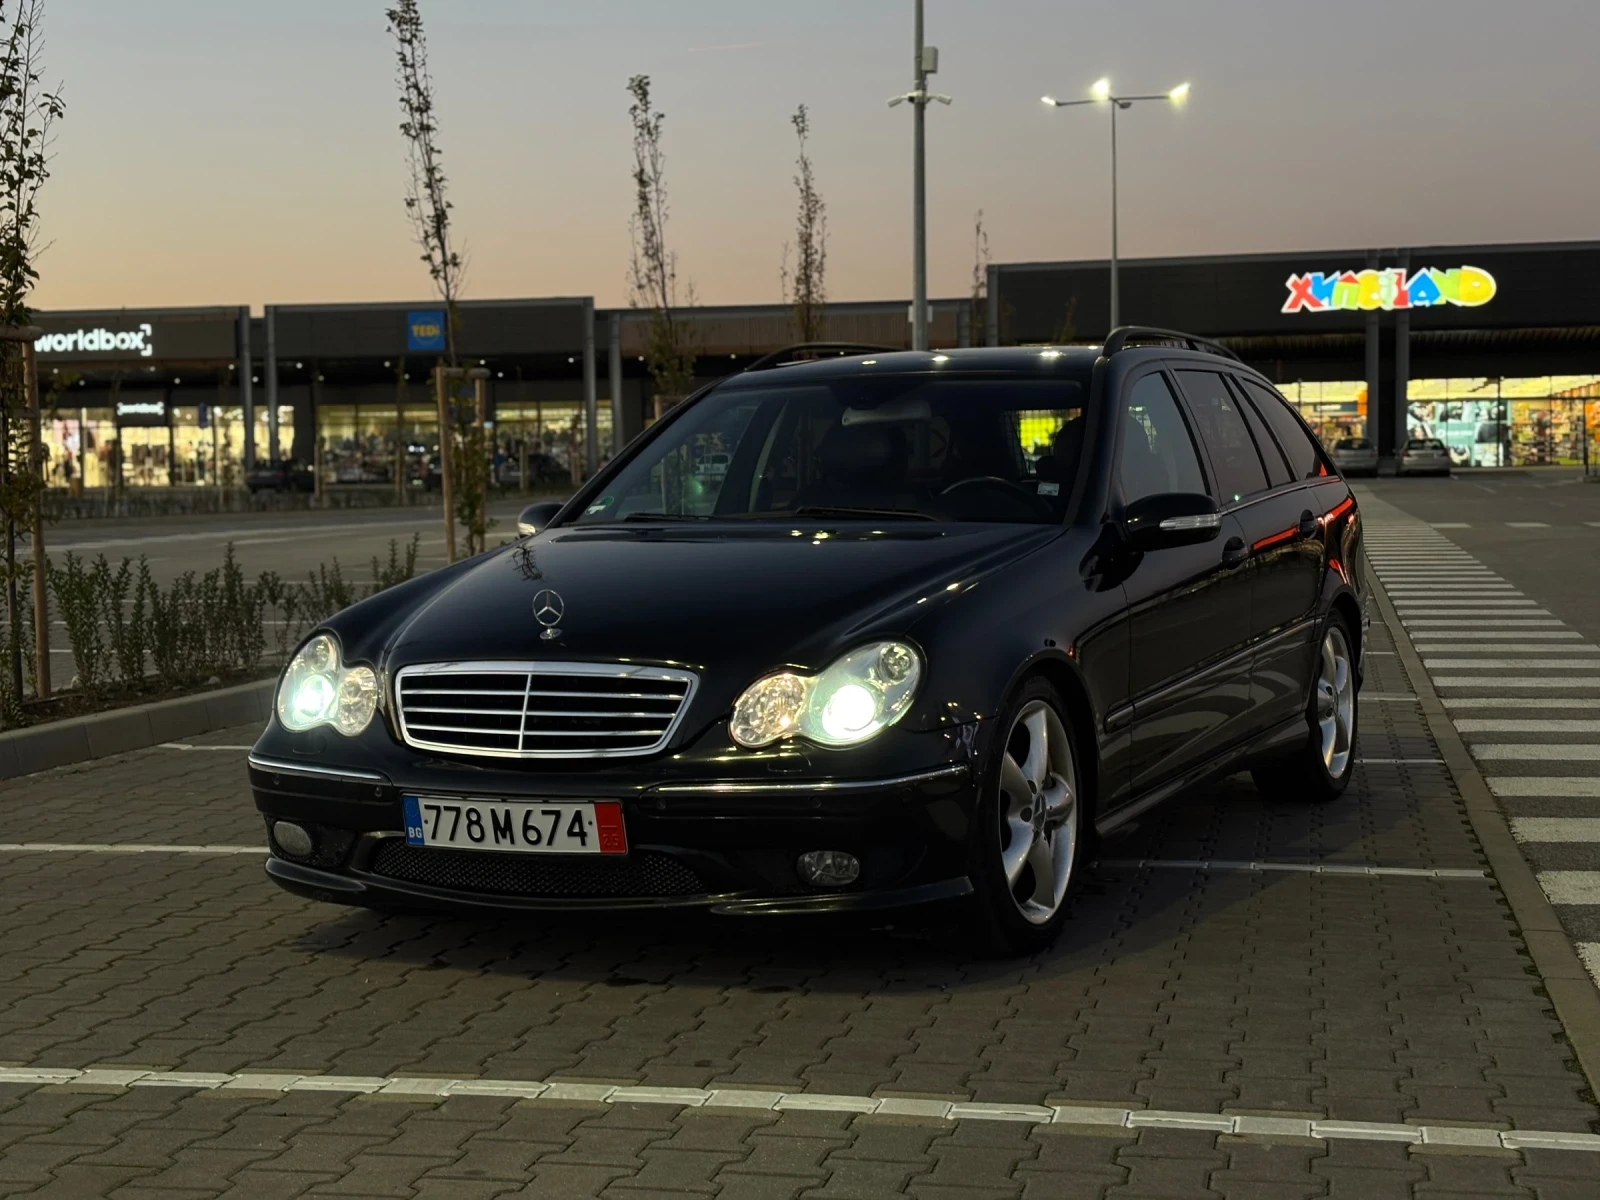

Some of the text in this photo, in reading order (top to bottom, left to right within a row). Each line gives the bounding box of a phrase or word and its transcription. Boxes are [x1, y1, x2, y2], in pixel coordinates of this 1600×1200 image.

[34, 328, 145, 352] worldbox
[408, 826, 423, 839] BG
[423, 803, 588, 847] 778M674
